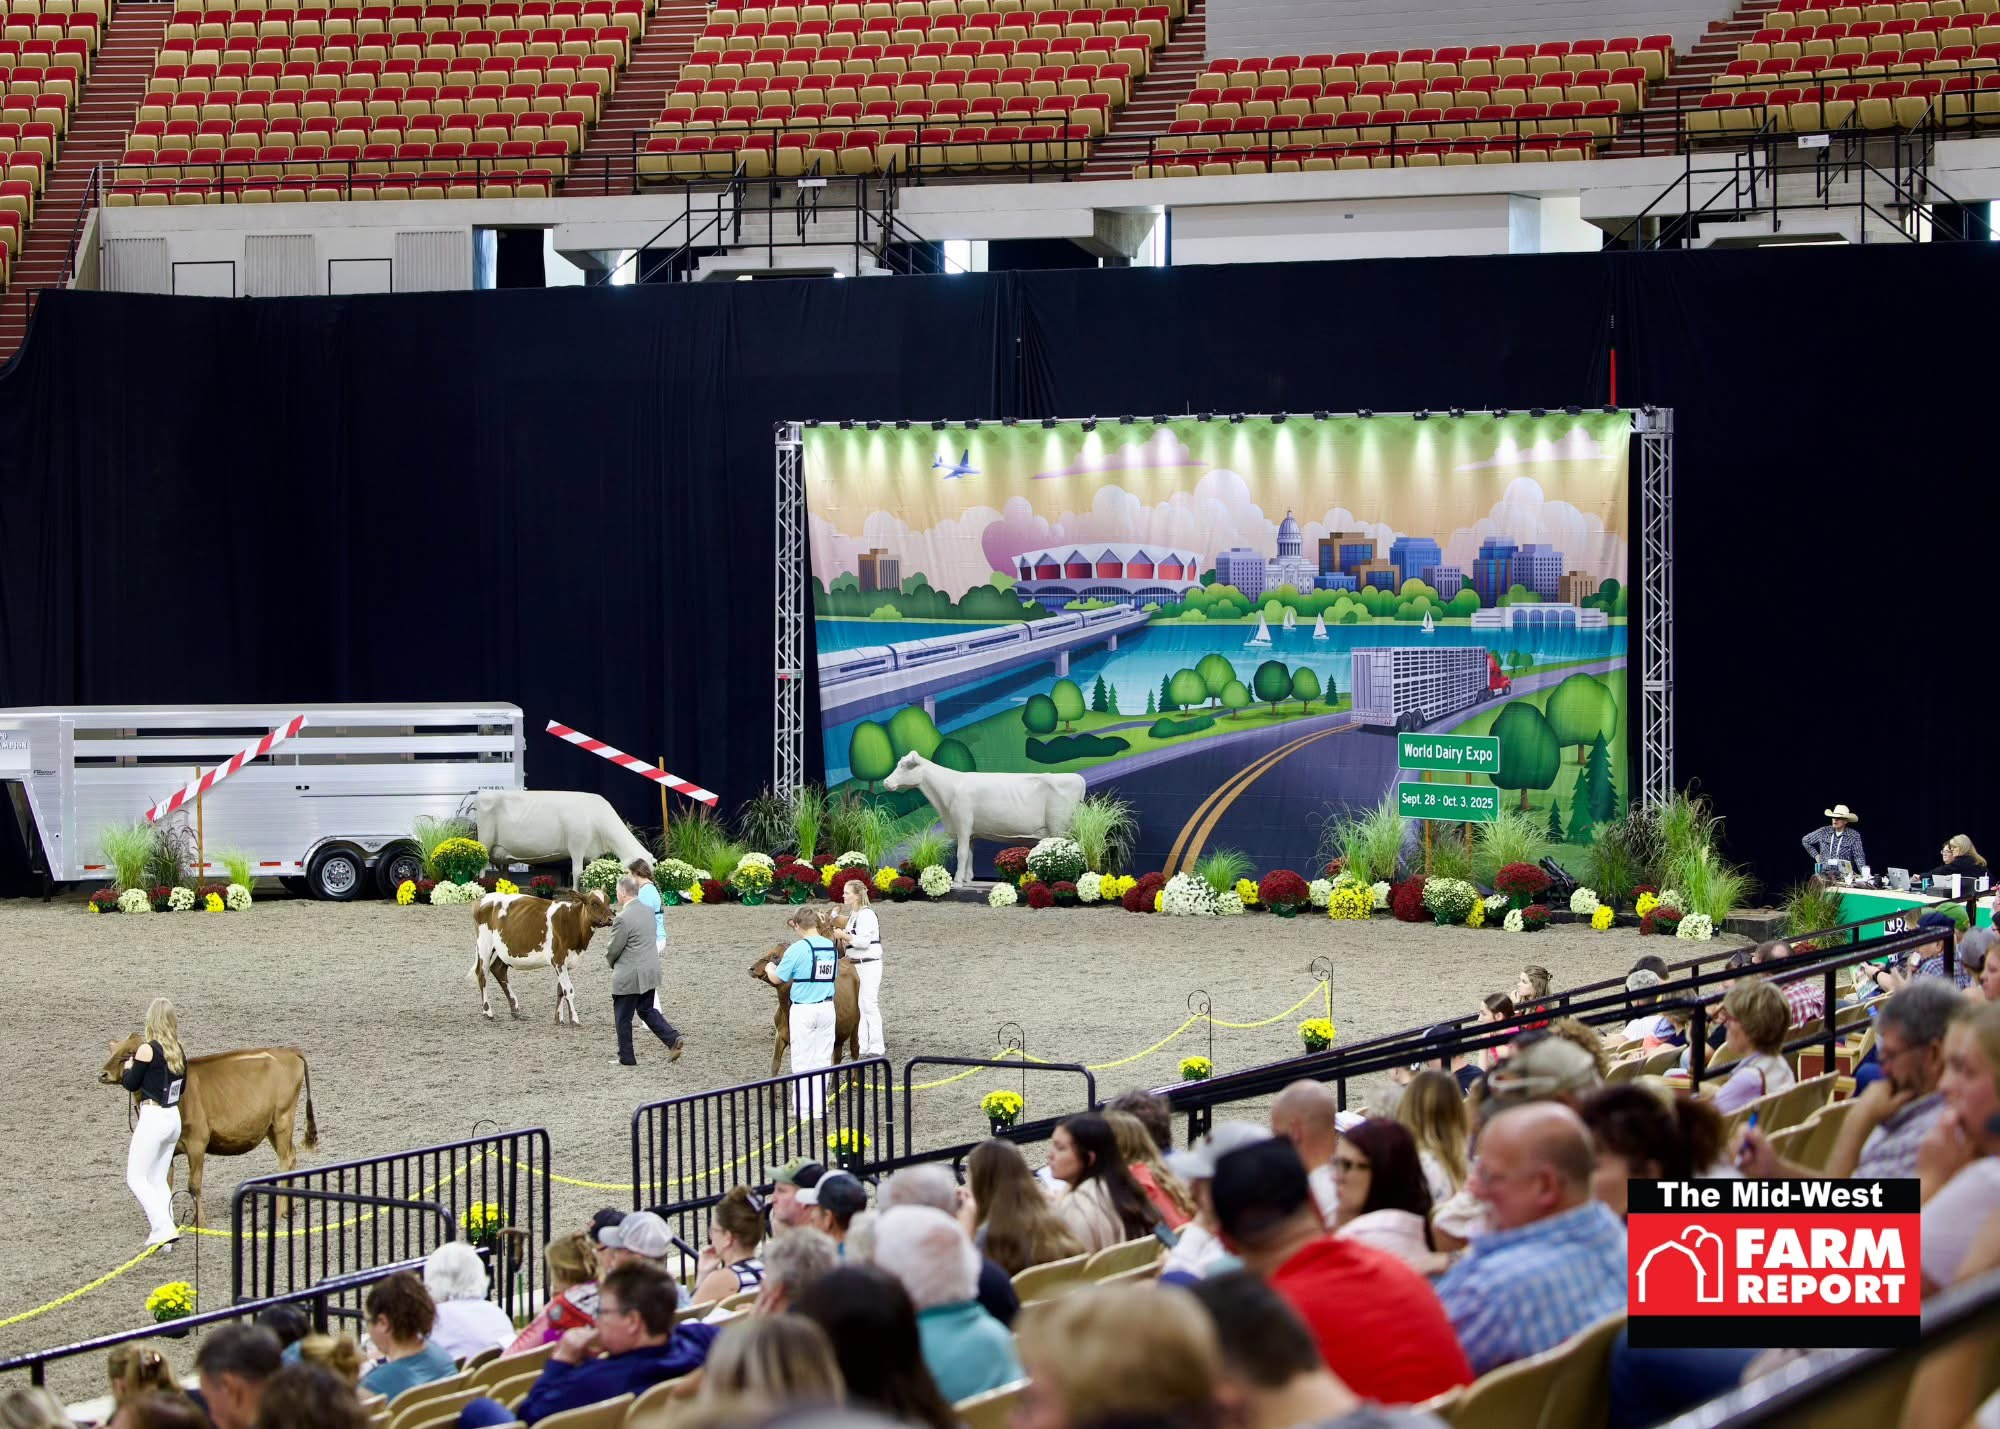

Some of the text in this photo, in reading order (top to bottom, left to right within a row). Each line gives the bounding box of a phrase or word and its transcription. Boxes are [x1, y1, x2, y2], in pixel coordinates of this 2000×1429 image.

[1404, 743, 1493, 765] World Dairy Expo
[1402, 792, 1422, 807] Sept.
[1424, 793, 1436, 805] 28
[1442, 795, 1458, 807] Oct.
[1470, 796, 1494, 809] 2025
[819, 964, 833, 975] 1461
